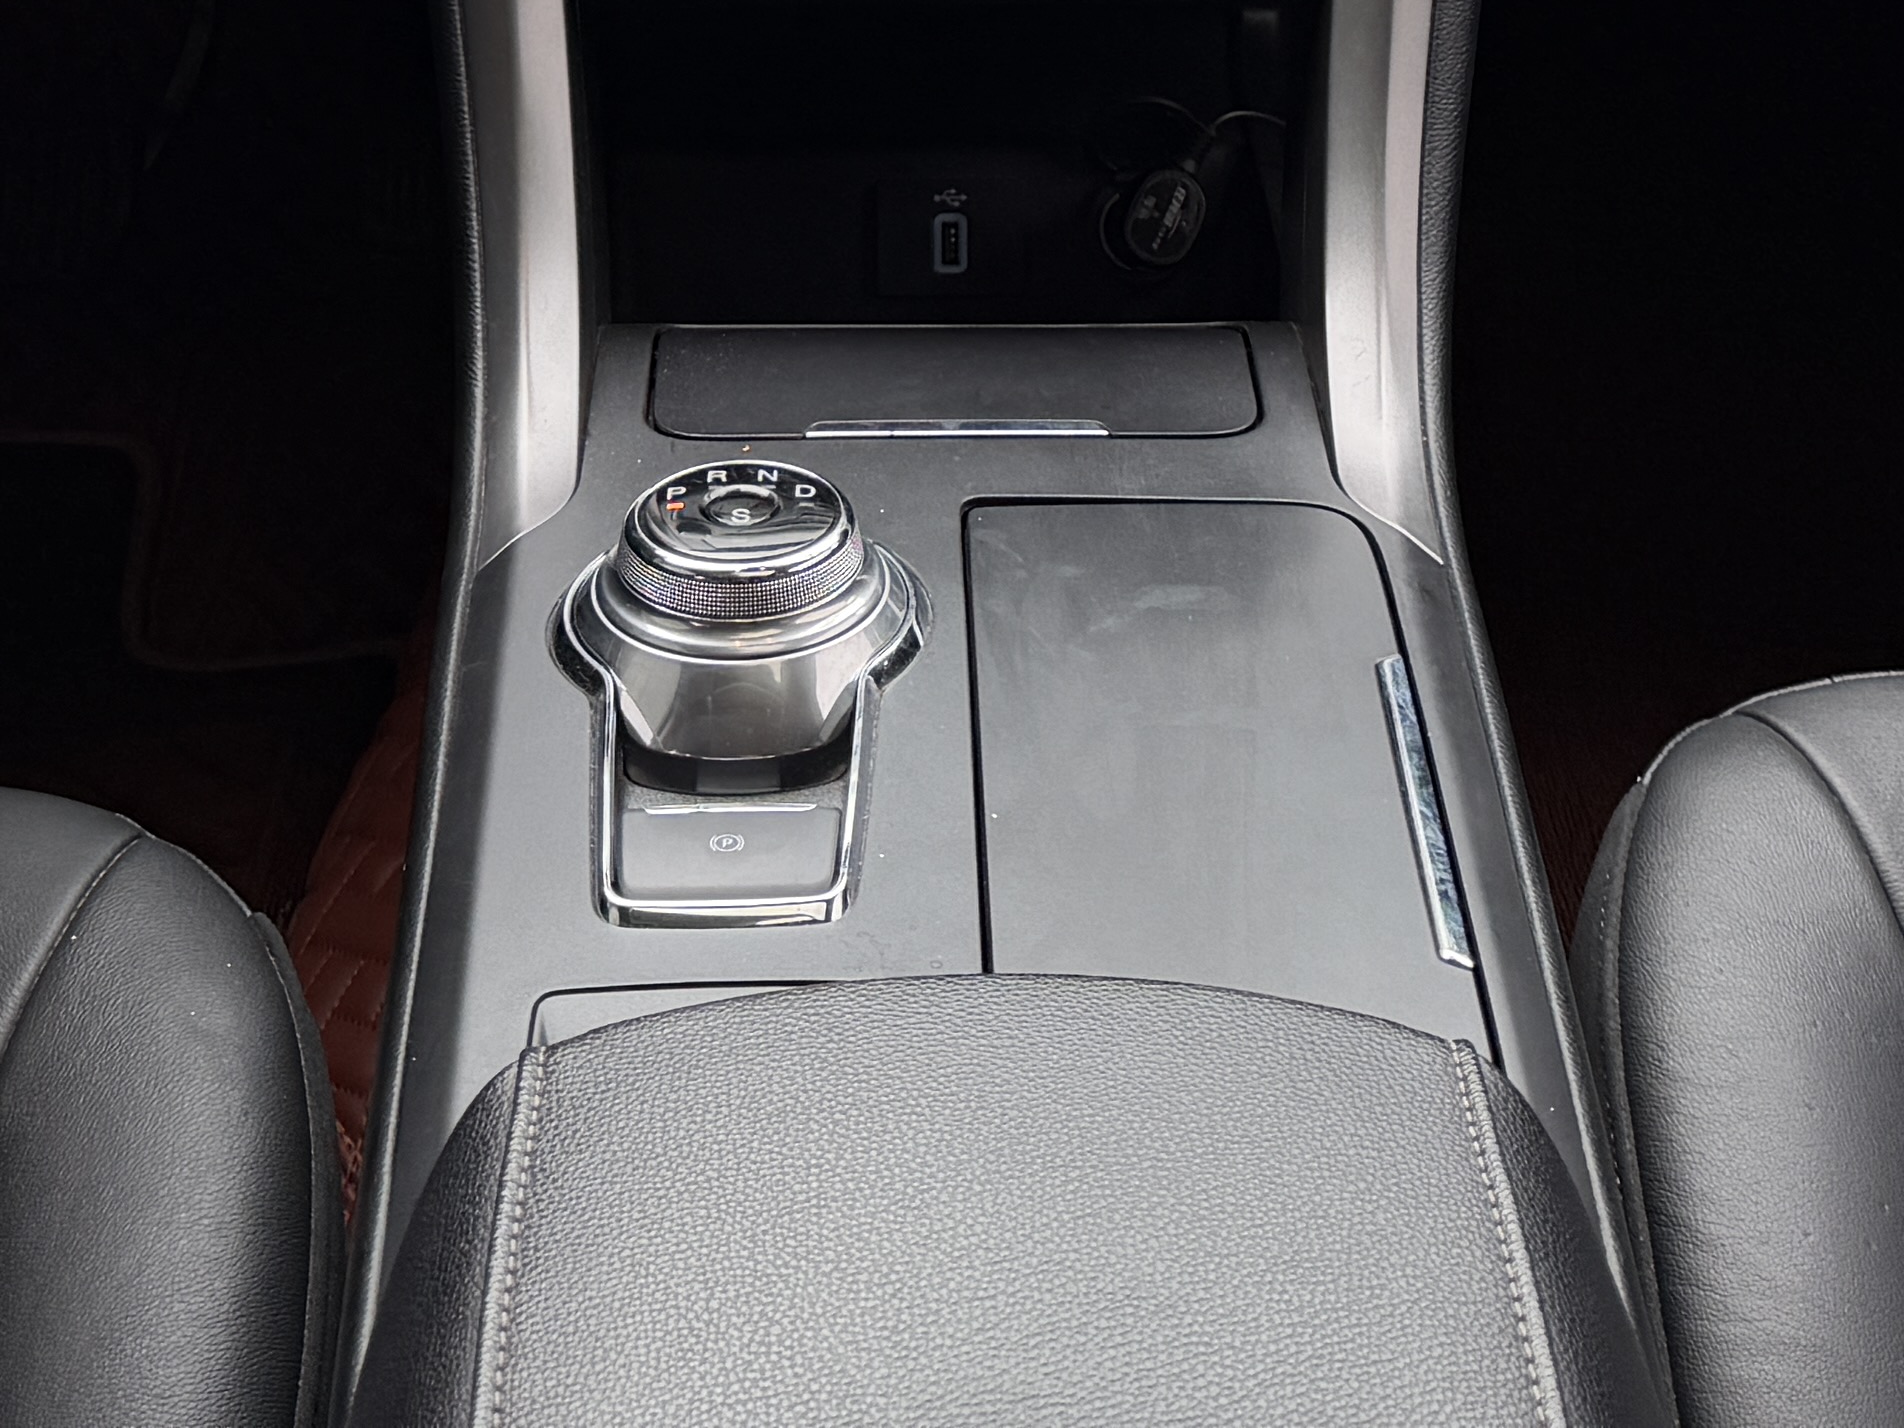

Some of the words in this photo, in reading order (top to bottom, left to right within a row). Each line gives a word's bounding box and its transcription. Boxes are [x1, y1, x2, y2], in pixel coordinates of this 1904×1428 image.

[707, 469, 727, 483] R
[757, 468, 779, 482] N
[667, 485, 686, 503] P
[795, 484, 816, 500] D
[730, 506, 752, 525] S
